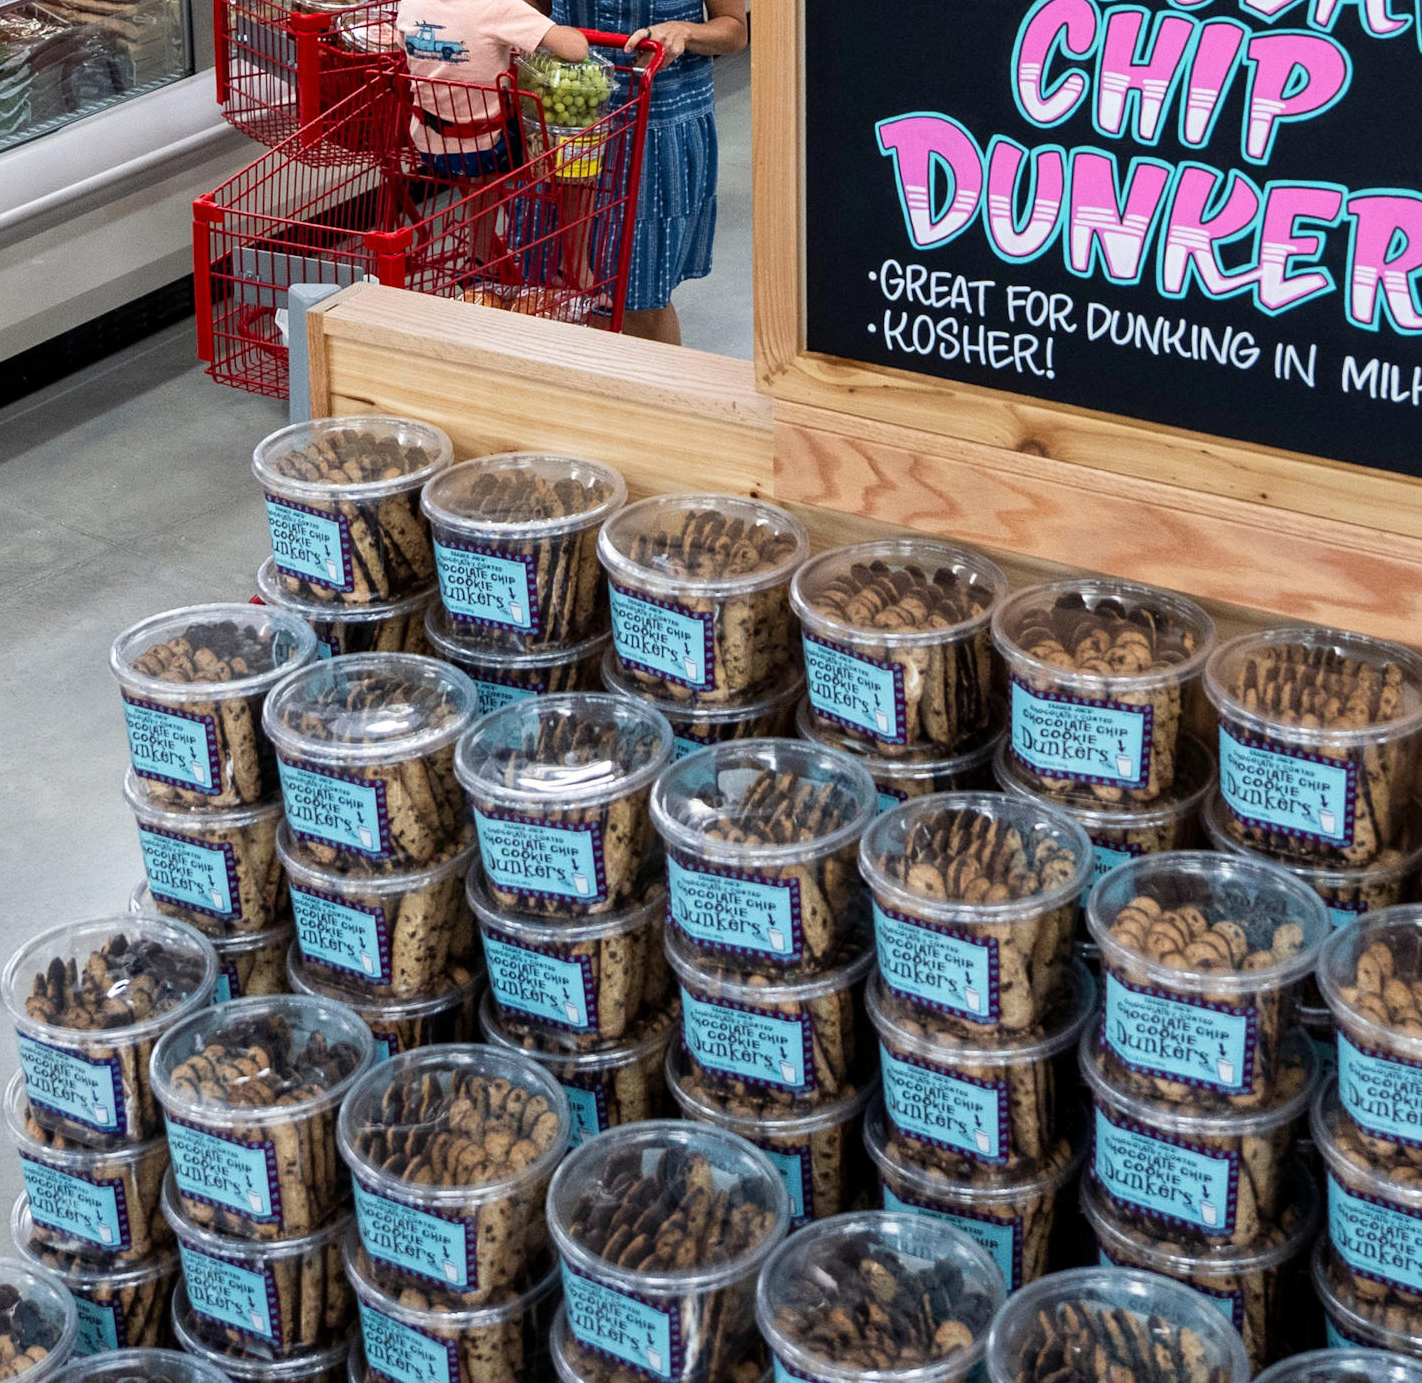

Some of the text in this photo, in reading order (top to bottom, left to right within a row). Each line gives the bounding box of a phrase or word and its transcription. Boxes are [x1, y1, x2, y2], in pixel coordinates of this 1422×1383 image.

[880, 263, 997, 319] GREAT
[1005, 285, 1078, 335] FOR
[1087, 302, 1261, 370] DUNKING
[1274, 342, 1317, 388] IN
[883, 309, 1057, 380] KOSHER!
[447, 574, 493, 593] COOKIE
[1022, 708, 1129, 738] CHOCOLATE CHIP
[1039, 728, 1097, 746] COOKIE
[1020, 724, 1109, 763] Dunkers
[1227, 753, 1331, 792] CHOCOLATE CHIP
[1242, 775, 1300, 798] COOKIE
[1226, 769, 1313, 817] Dunkers
